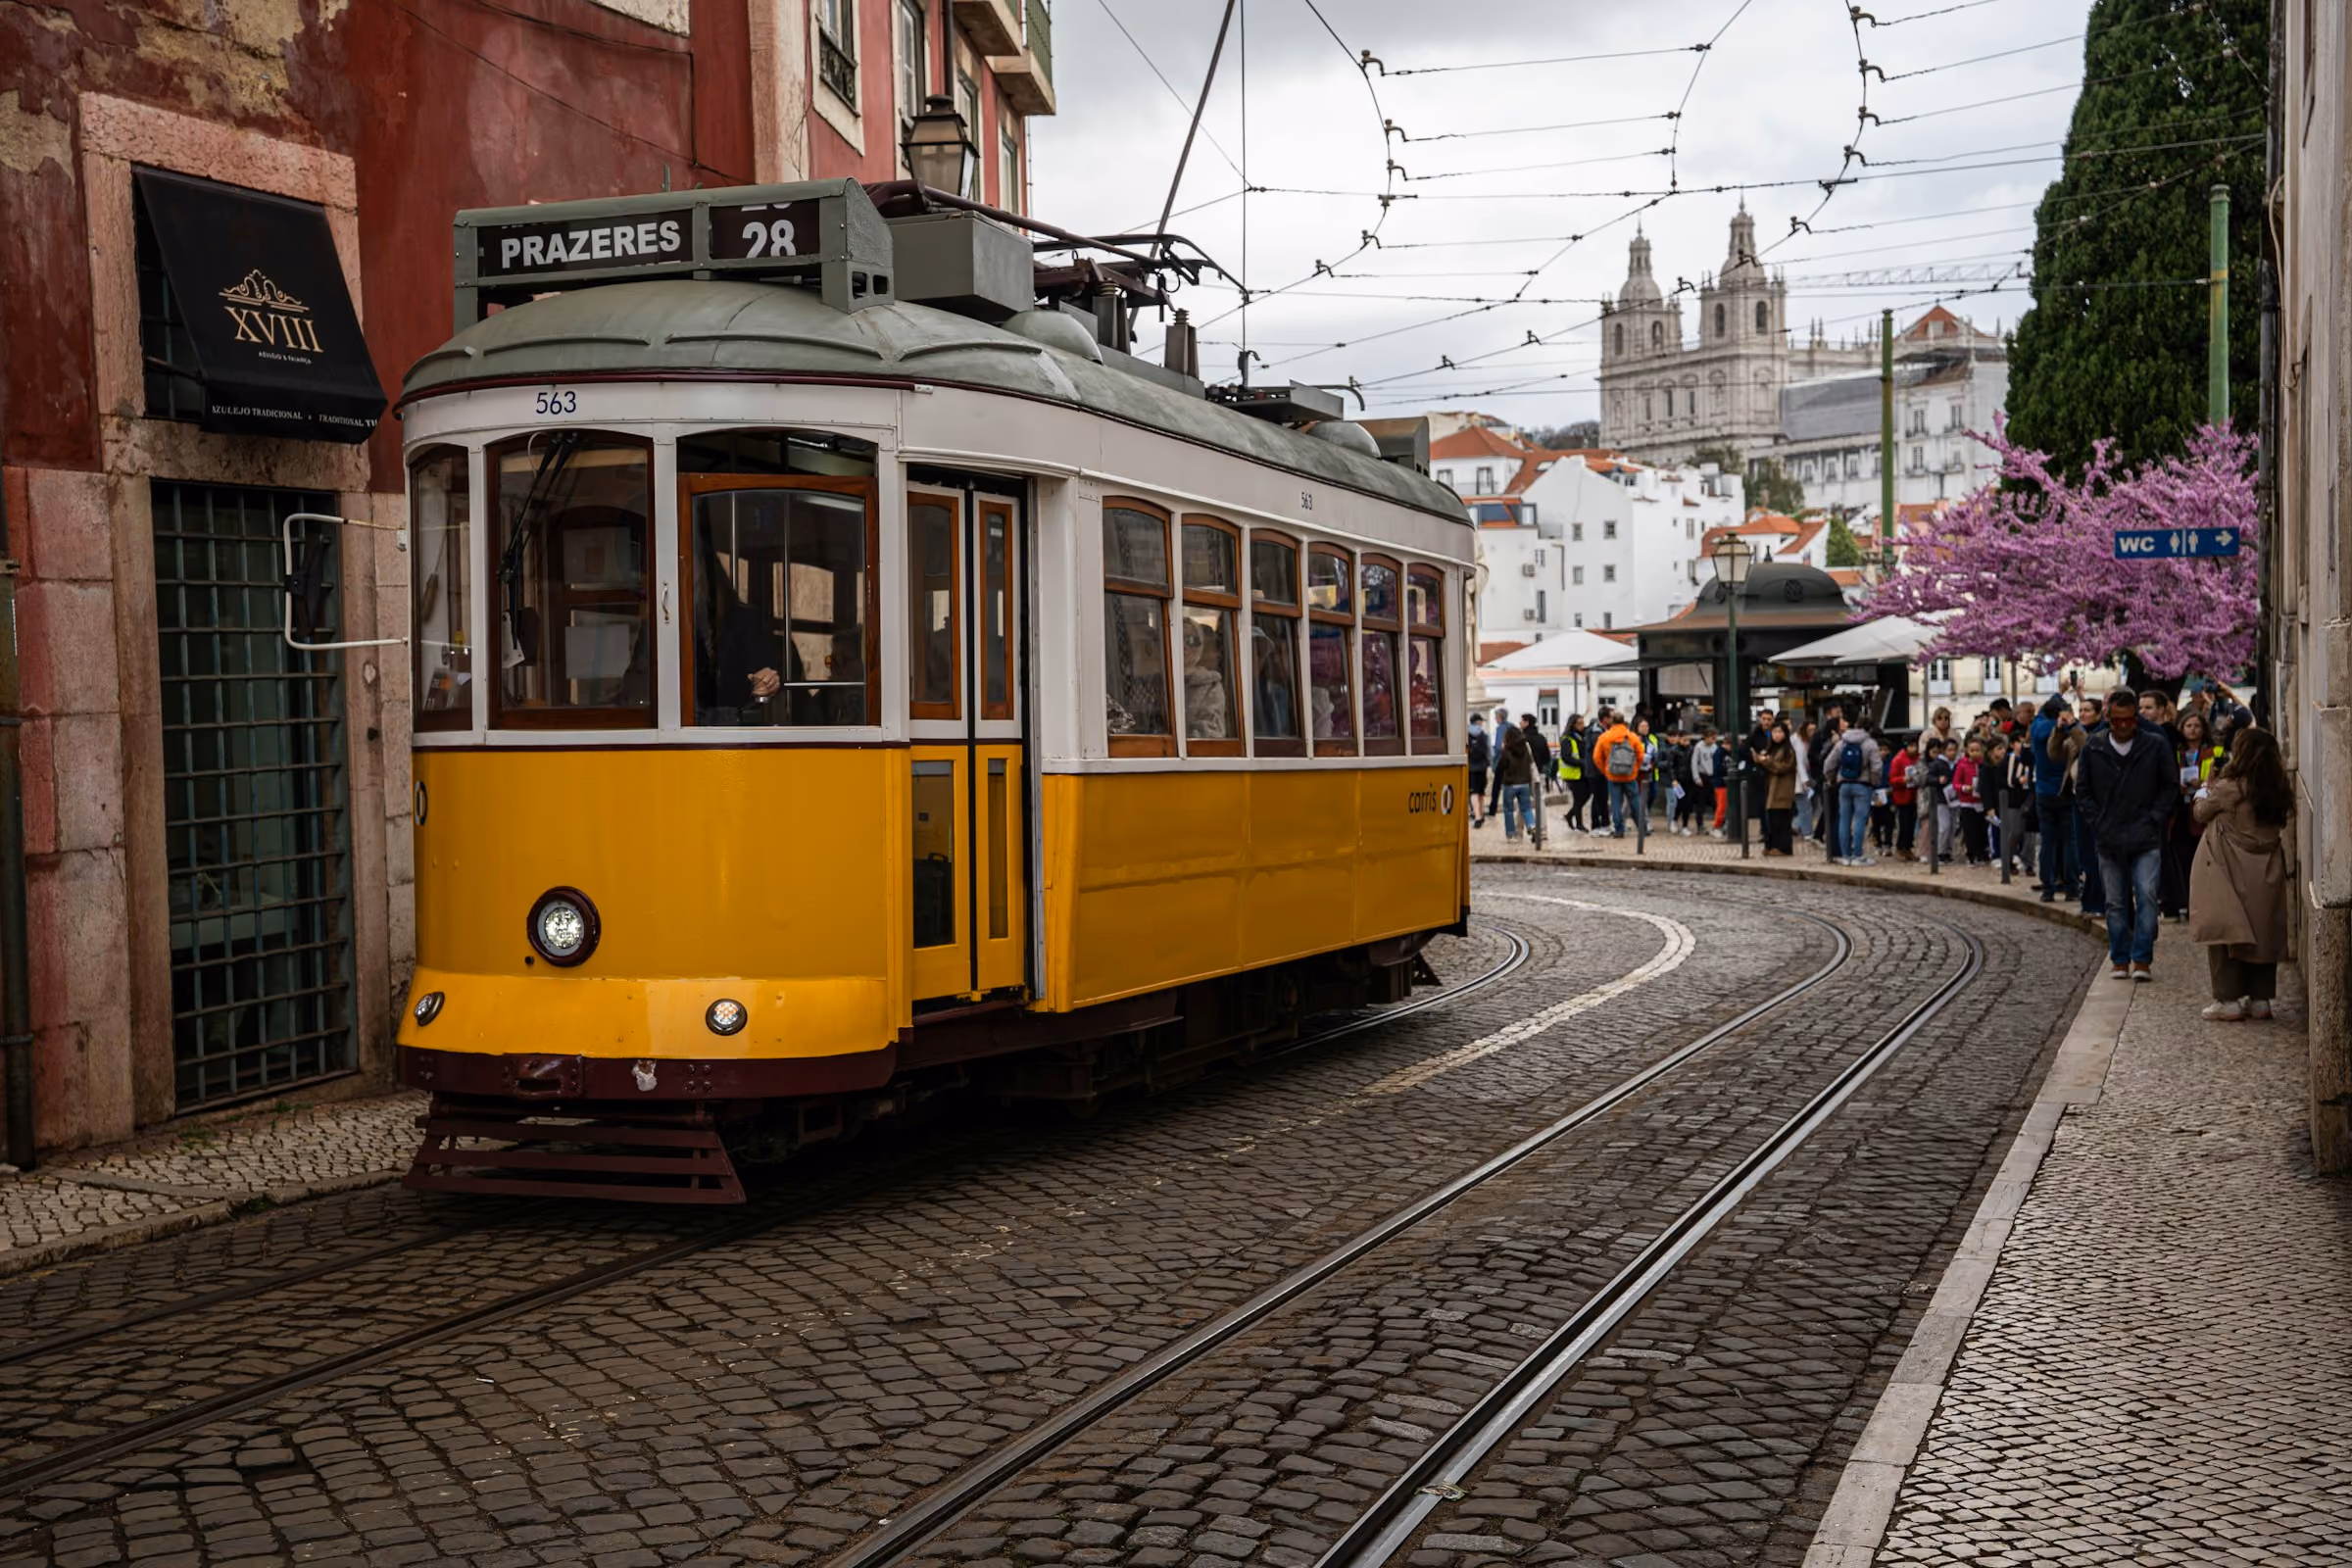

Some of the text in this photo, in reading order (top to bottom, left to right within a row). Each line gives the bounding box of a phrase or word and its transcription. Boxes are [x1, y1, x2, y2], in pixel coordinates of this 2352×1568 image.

[502, 220, 796, 269] PRAZERES 28
[223, 306, 323, 353] XVIII
[536, 391, 576, 415] 563
[212, 405, 251, 416] AZULEJO
[252, 408, 303, 419] TRADICIONAL
[318, 414, 365, 427] TRADITIONAL
[1301, 491, 1312, 510] 563
[2119, 536, 2155, 553] WC
[1408, 782, 1437, 813] carris
